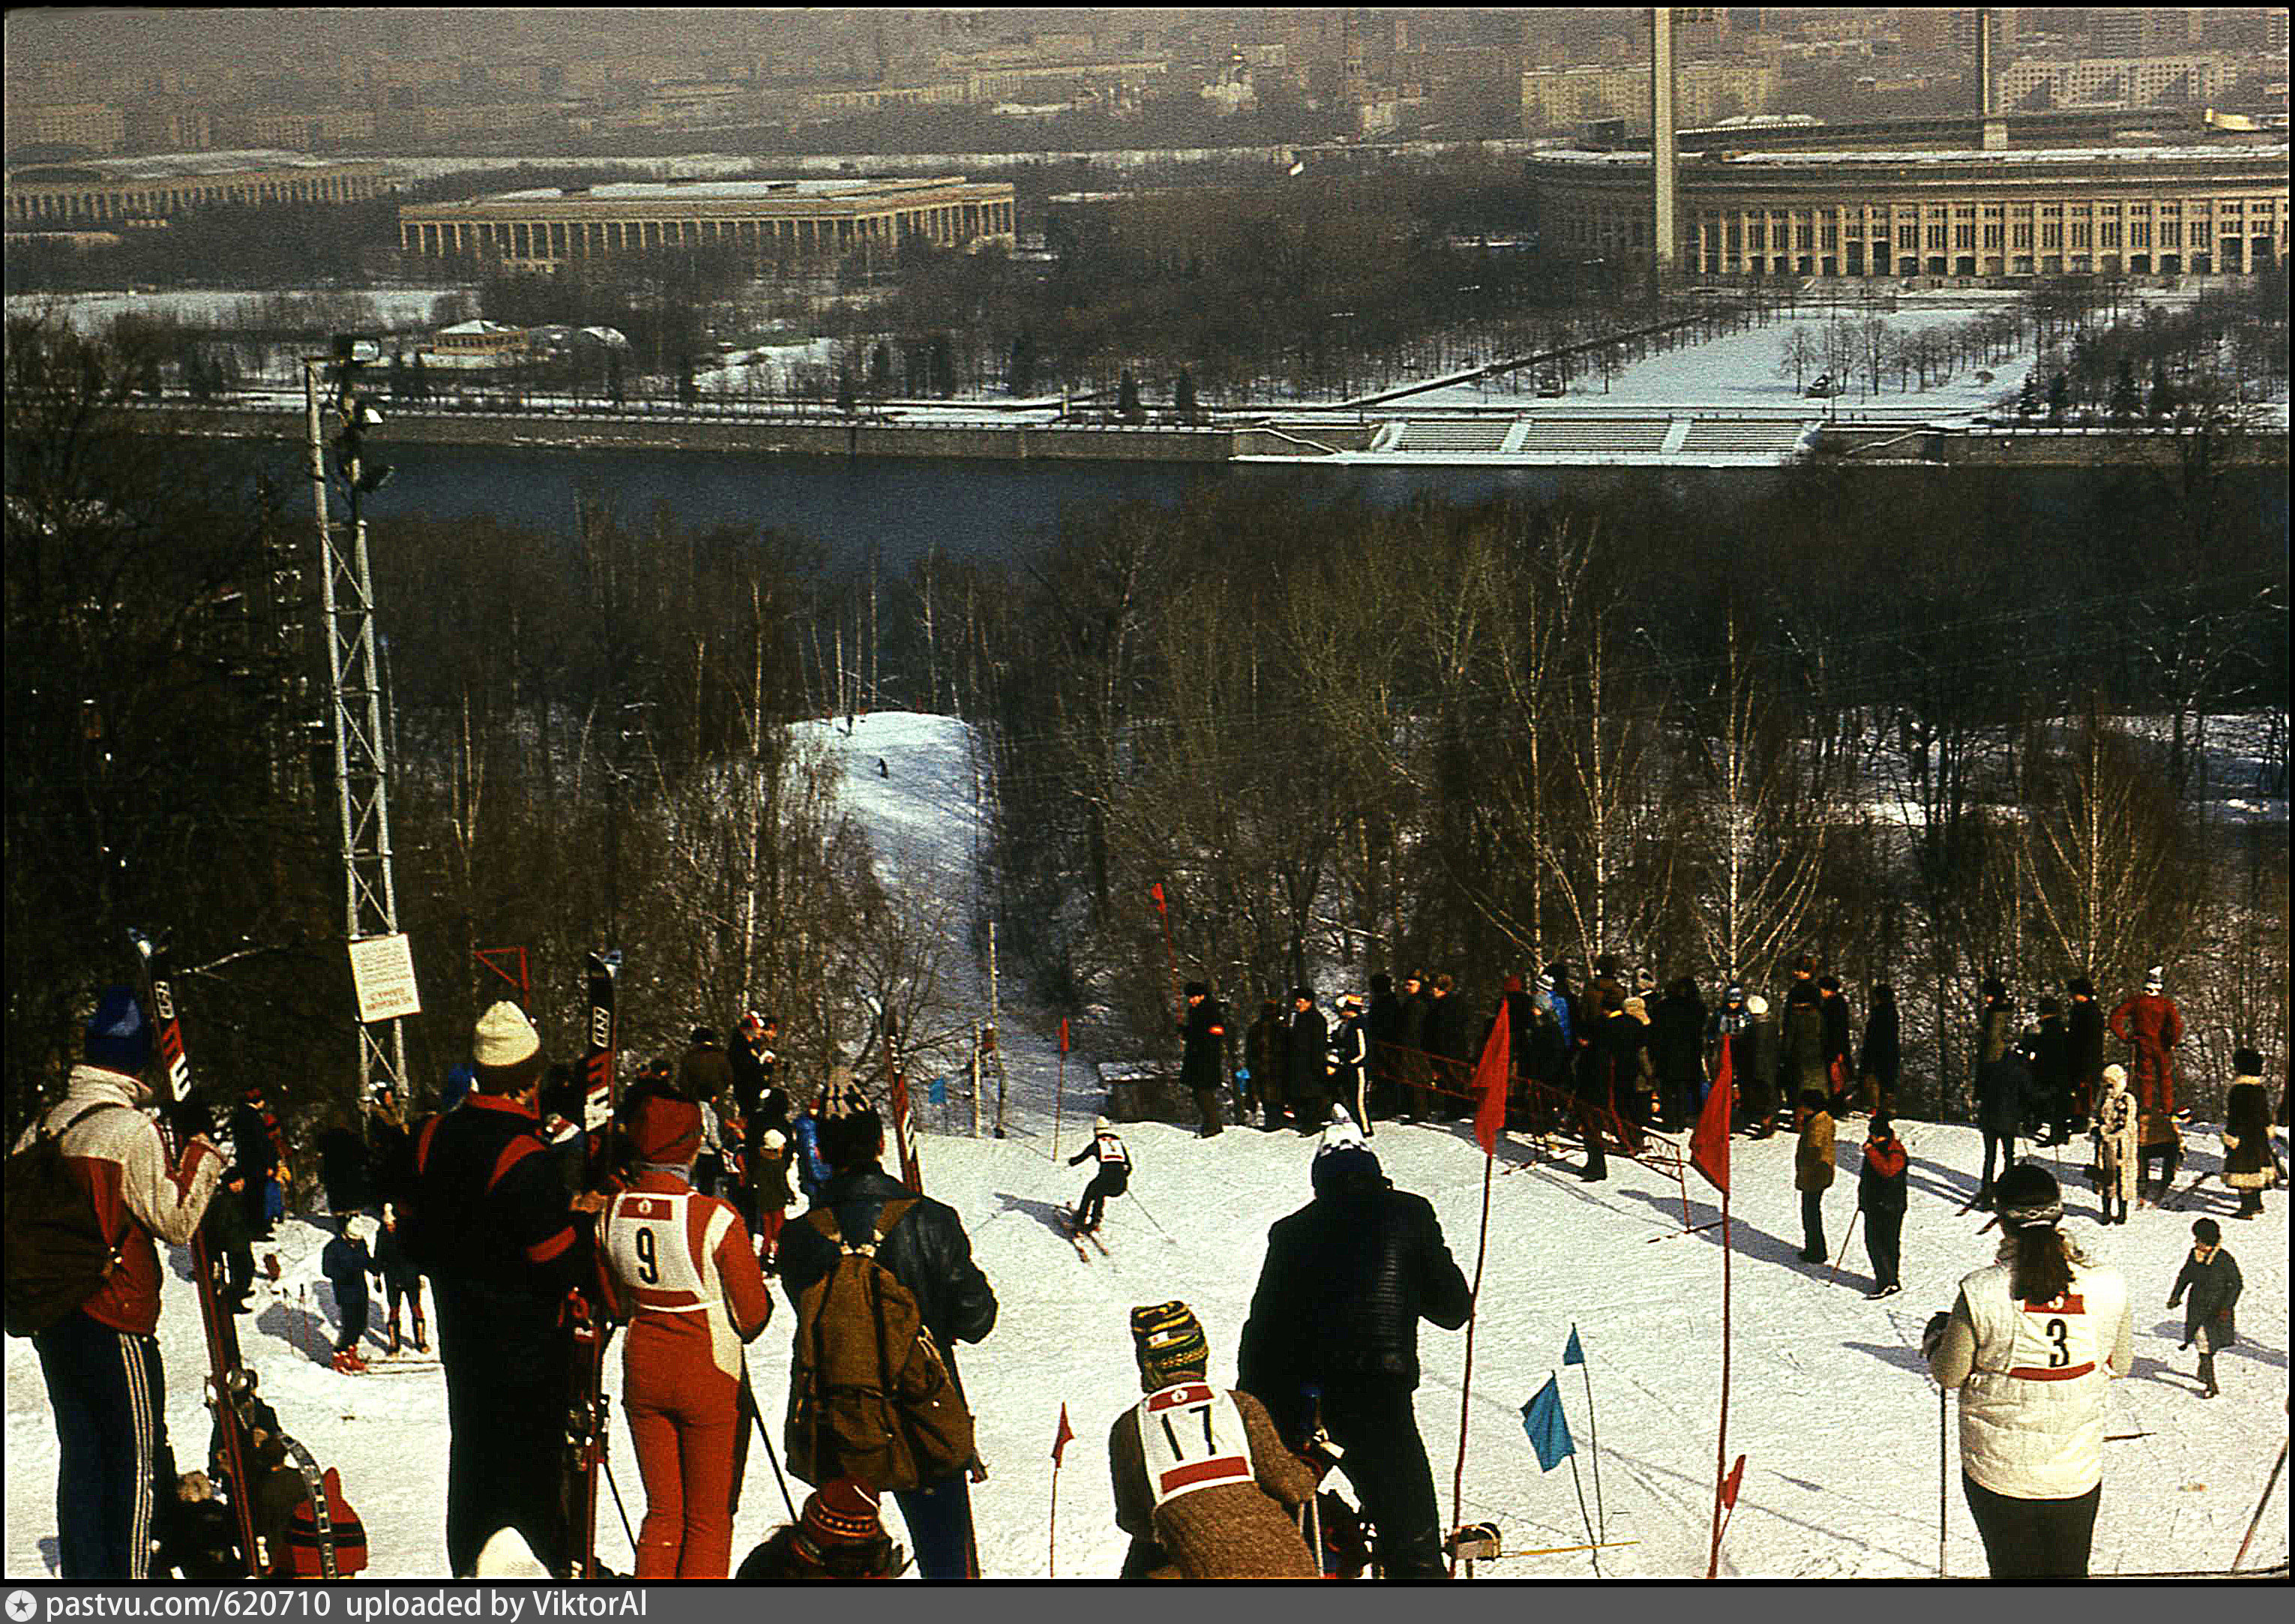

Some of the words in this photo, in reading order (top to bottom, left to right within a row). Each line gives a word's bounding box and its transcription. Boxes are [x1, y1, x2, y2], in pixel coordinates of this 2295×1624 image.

[636, 1227, 658, 1284] 9
[2046, 1318, 2070, 1368] 3
[1161, 1404, 1217, 1461] 17
